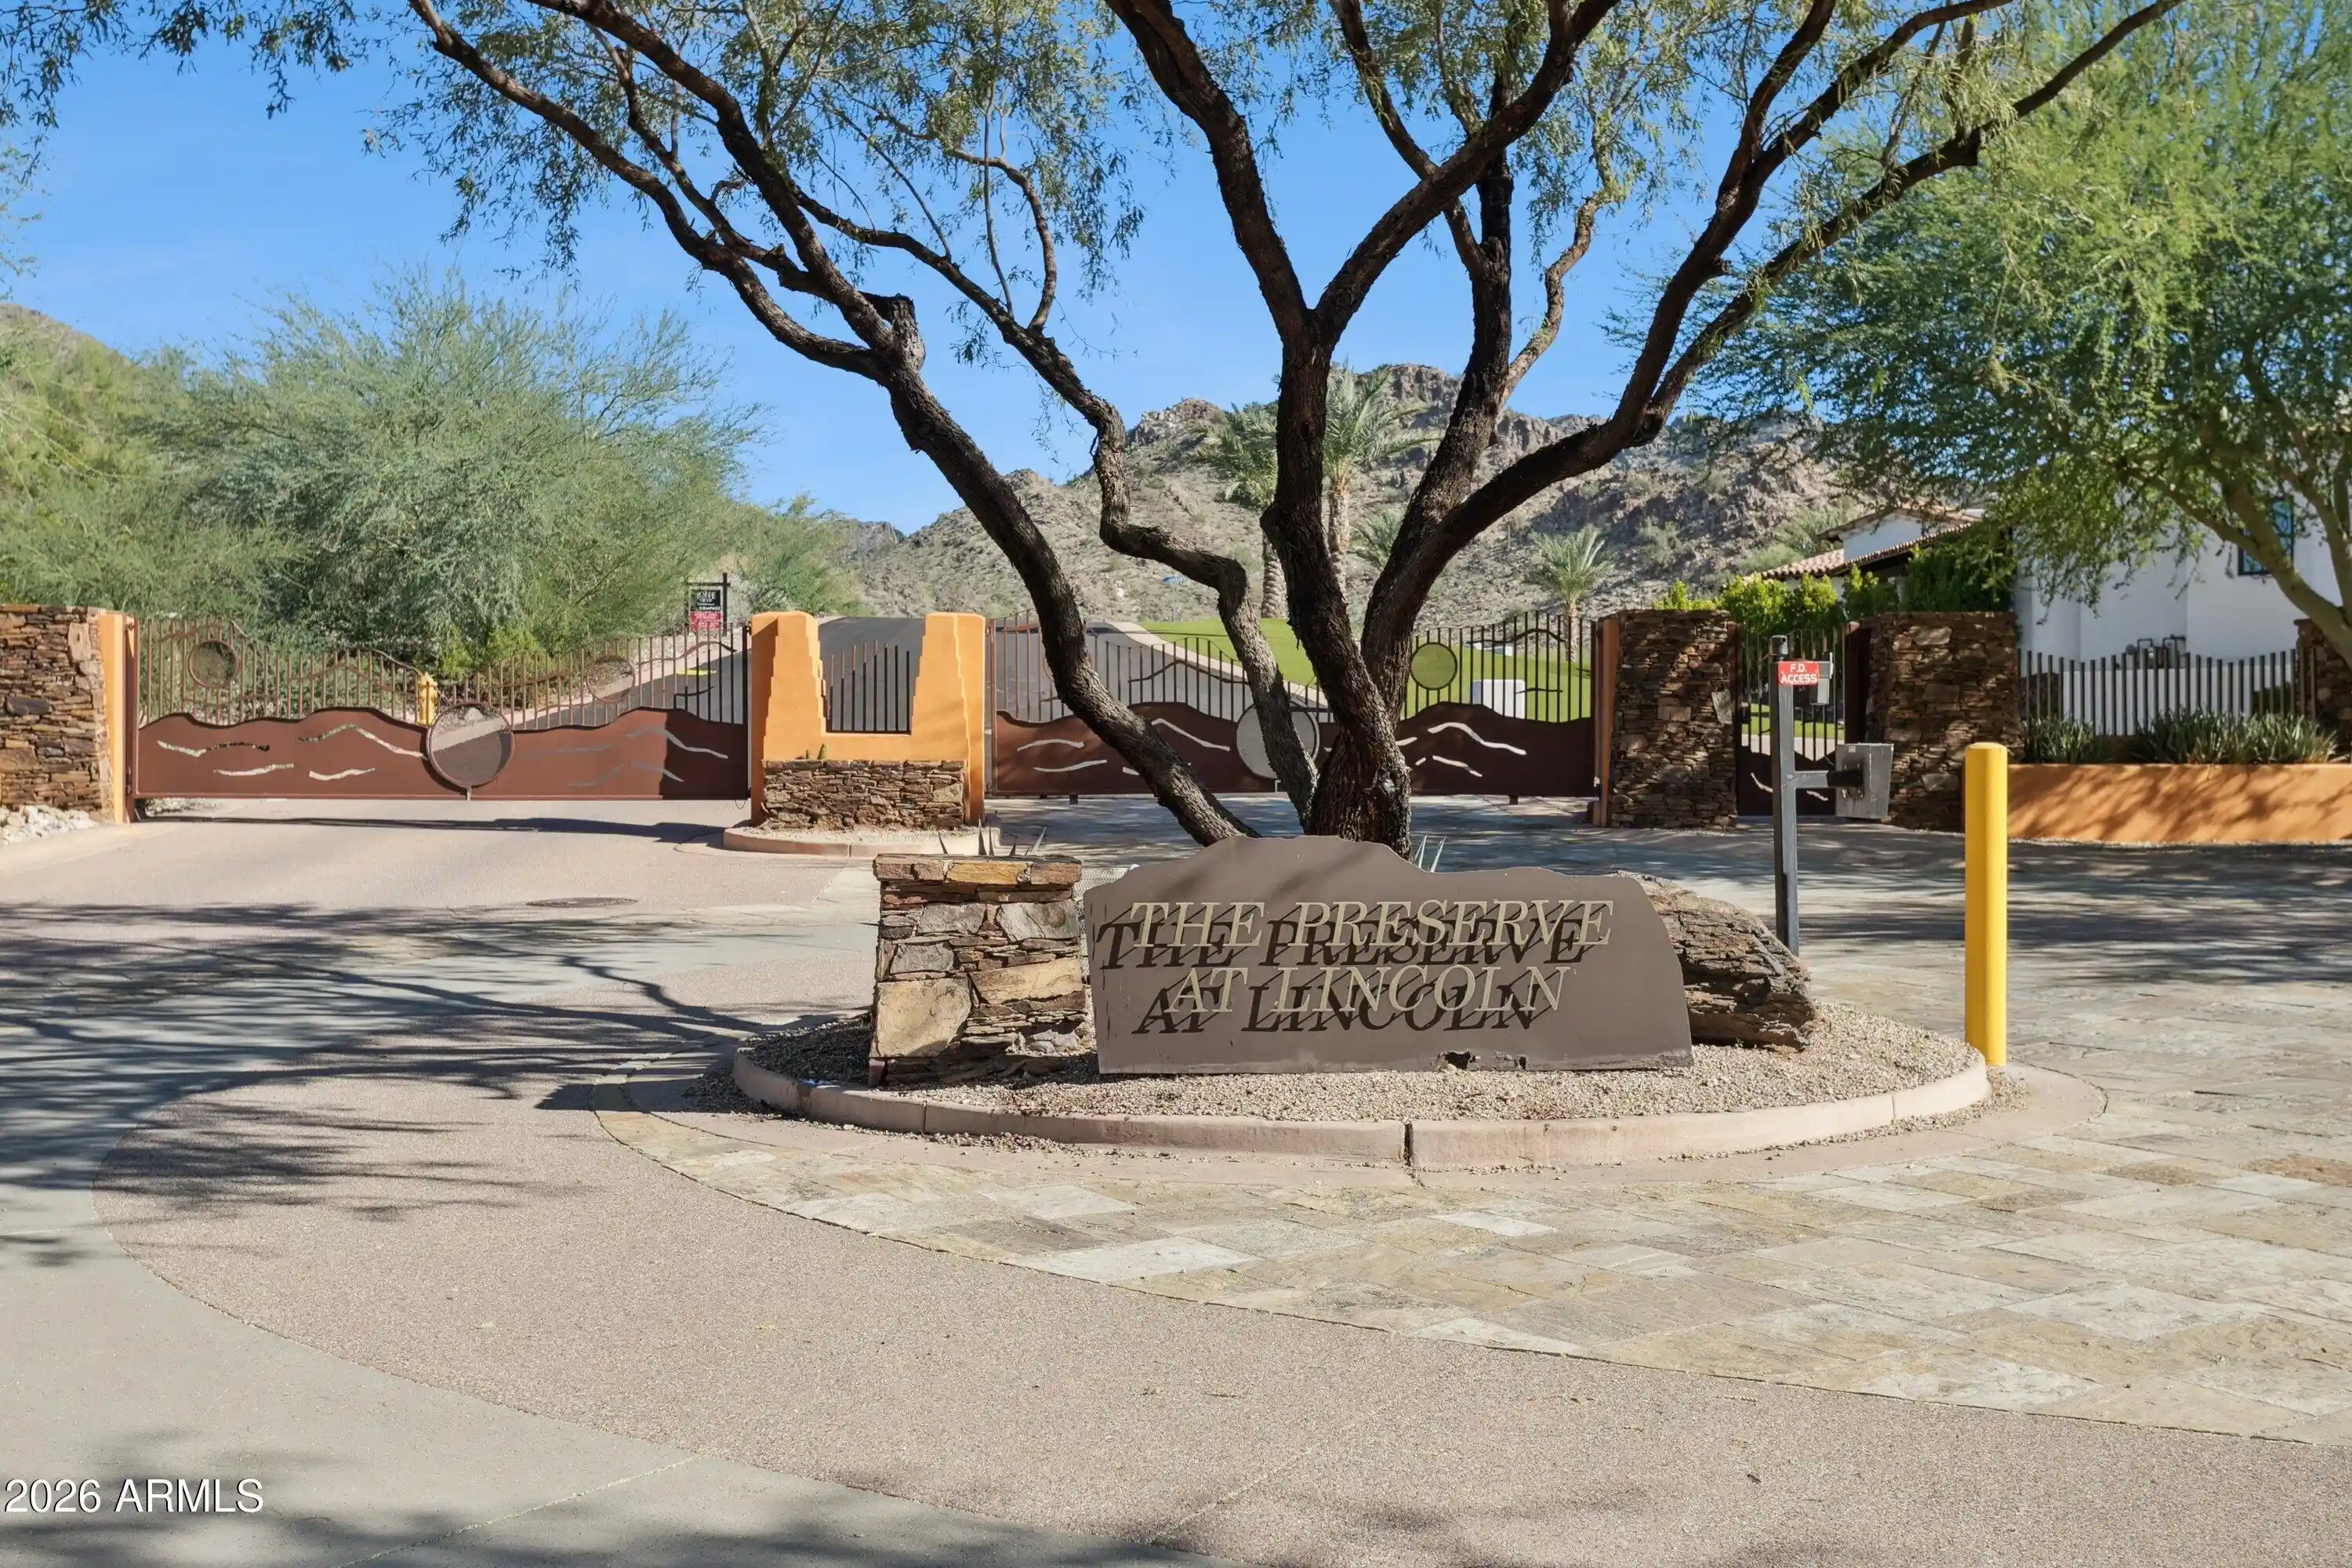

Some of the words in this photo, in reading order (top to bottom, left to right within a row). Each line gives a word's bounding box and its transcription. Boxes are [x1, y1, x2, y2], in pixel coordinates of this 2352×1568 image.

[1780, 673, 1817, 684] ACCESS
[1131, 902, 1265, 948] THE
[1290, 900, 1613, 946] PRESERVE
[1167, 967, 1248, 1013] AT
[1272, 964, 1570, 1014] LINCOLN
